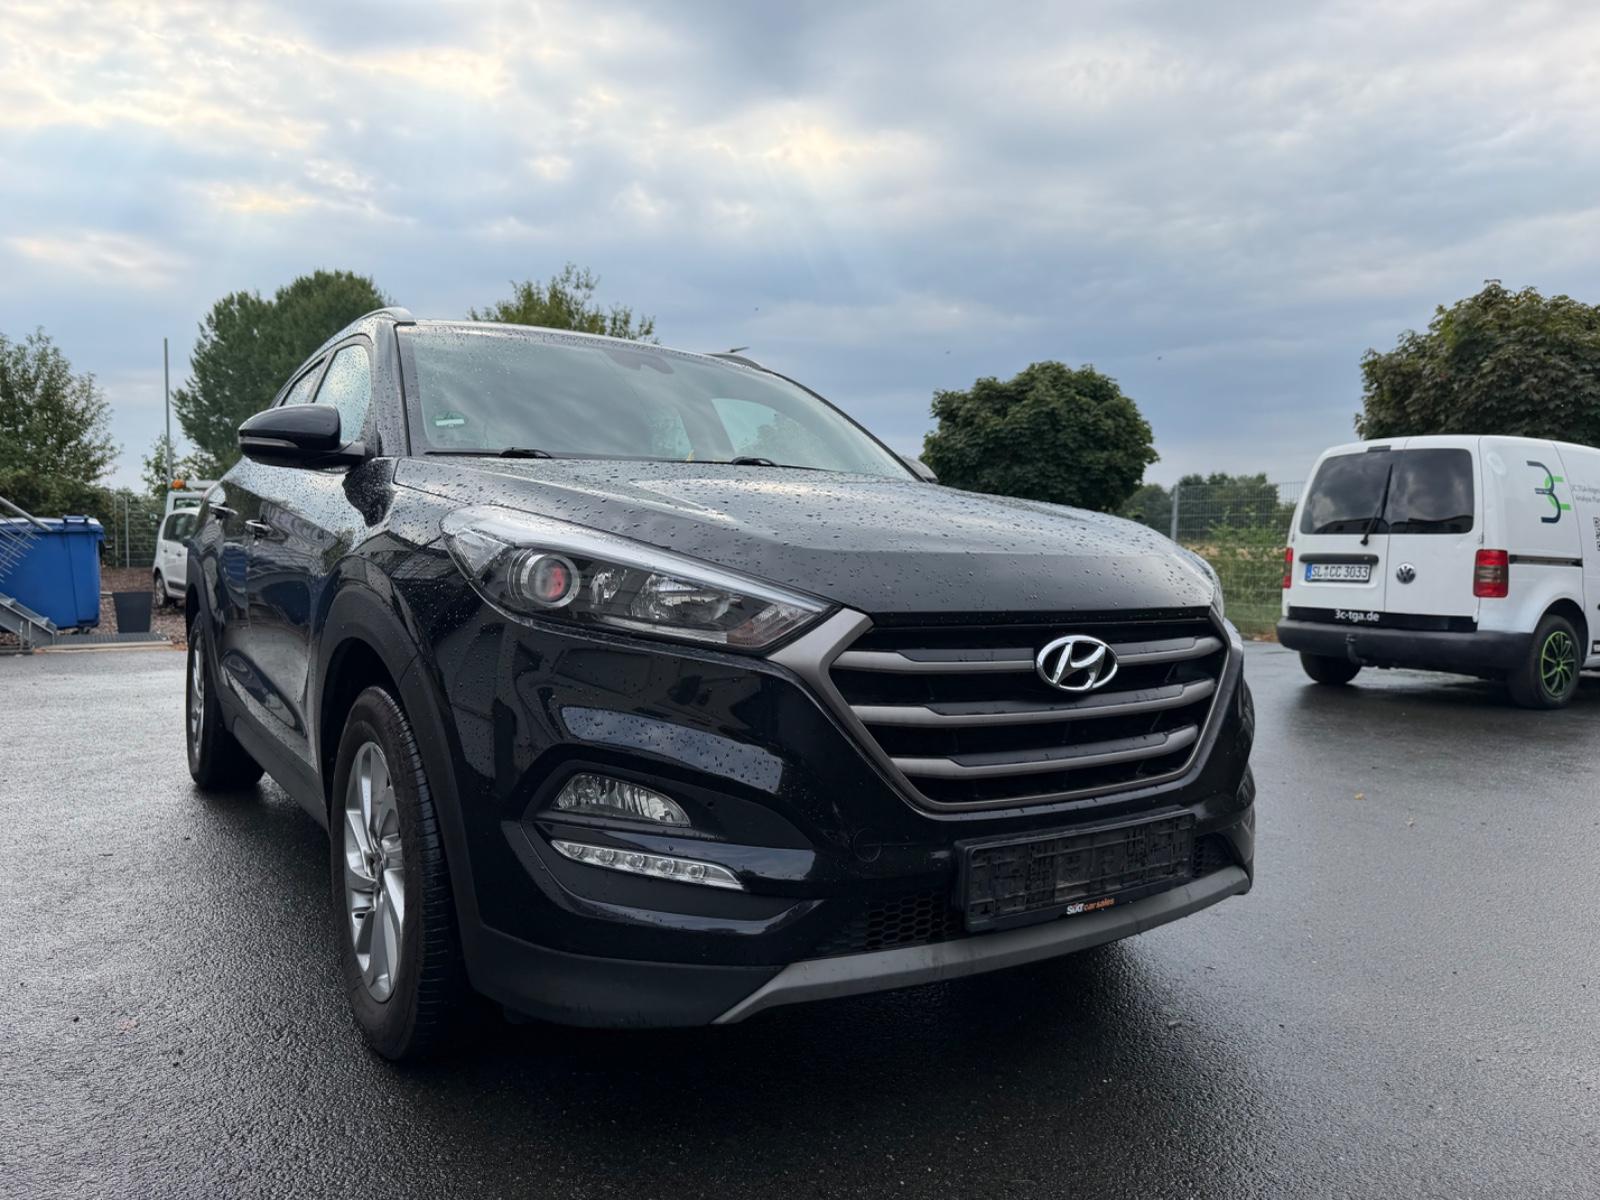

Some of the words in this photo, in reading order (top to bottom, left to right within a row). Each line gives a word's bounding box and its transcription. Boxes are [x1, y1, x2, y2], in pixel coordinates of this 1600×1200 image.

[1312, 566, 1322, 577] SL
[1343, 566, 1368, 578] 3033
[1334, 608, 1380, 623] 3c-tga.de
